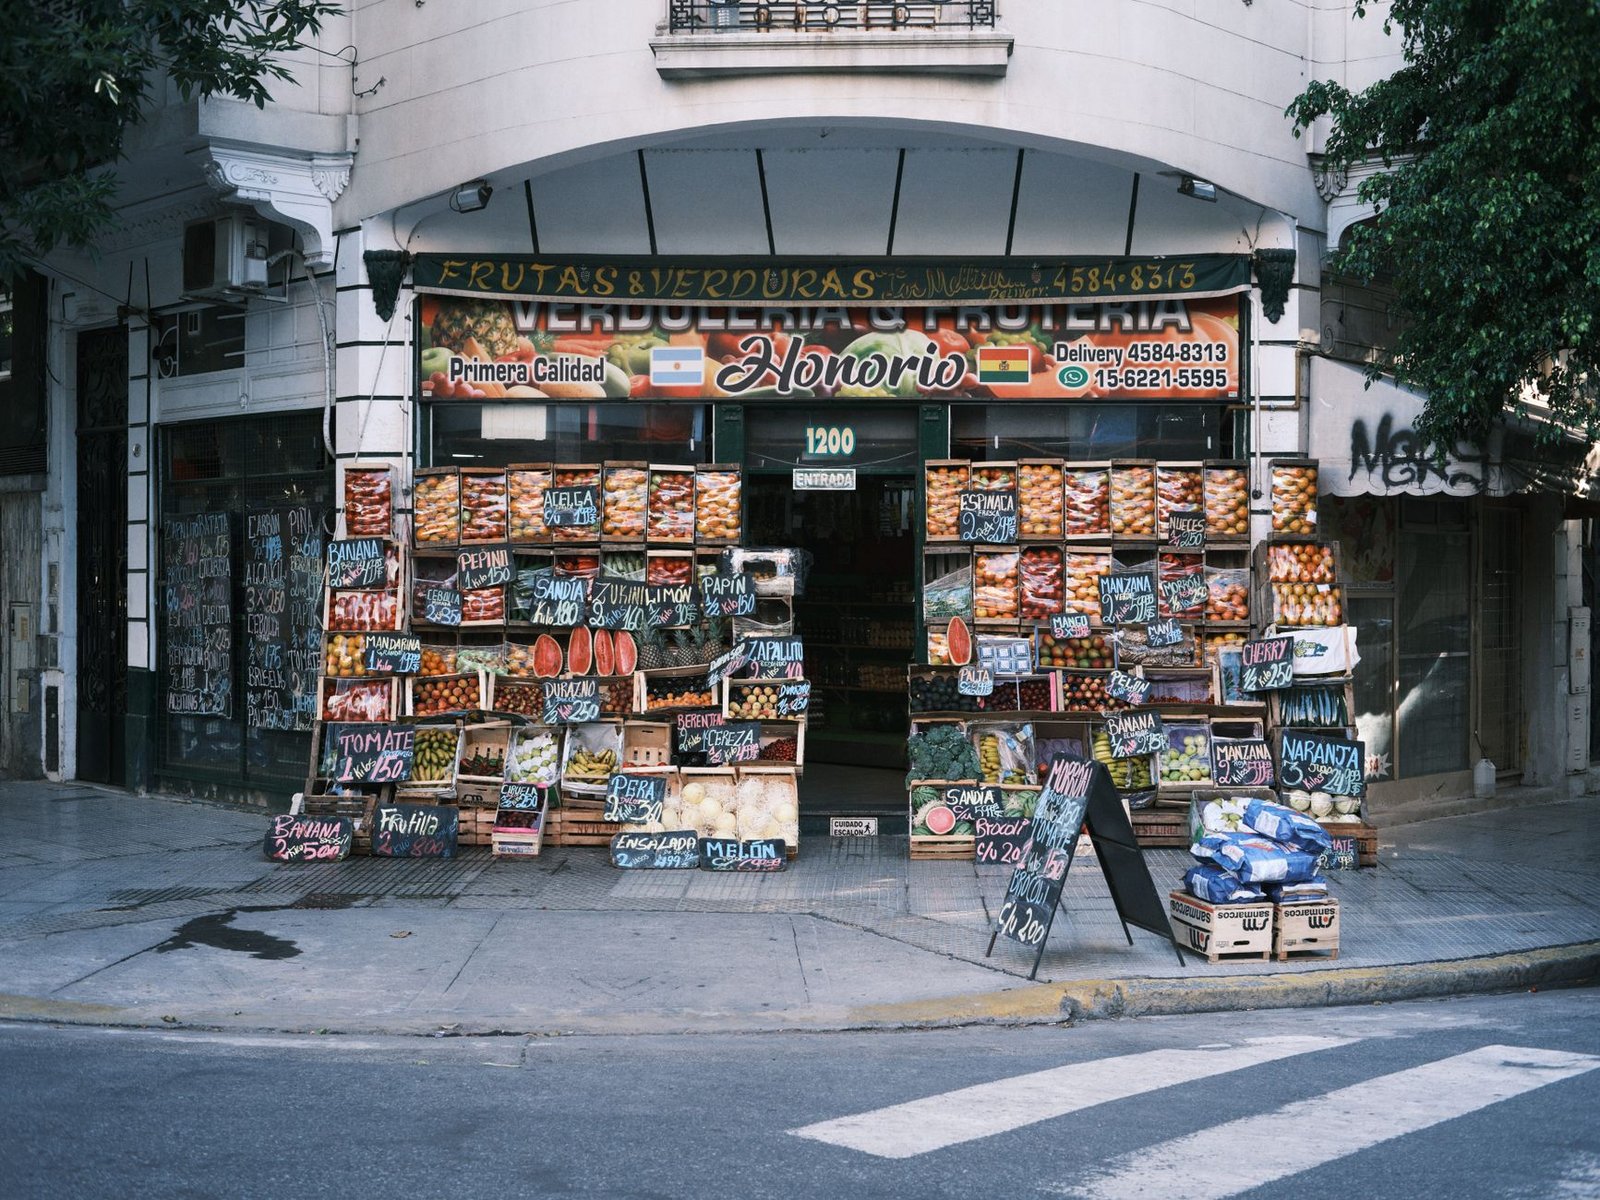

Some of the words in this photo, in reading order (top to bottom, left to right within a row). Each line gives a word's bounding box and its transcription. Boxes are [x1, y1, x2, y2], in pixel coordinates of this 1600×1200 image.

[438, 260, 618, 295] FRUTAS
[627, 271, 645, 295] &
[651, 265, 876, 299] VERDURAS
[716, 335, 966, 392] Honorio
[1056, 343, 1122, 367] Delivery
[1128, 343, 1227, 362] 4584-8313
[449, 357, 528, 382] Primera
[534, 357, 605, 382] Calidad
[1095, 369, 1227, 388] 15-6221-5595
[806, 427, 854, 454] 1200
[795, 472, 853, 487] ENTRADA
[960, 494, 1014, 511] ESPINACA
[288, 507, 314, 536] PIÑA
[1169, 517, 1205, 532] NUECES
[303, 530, 320, 556] 600
[328, 540, 379, 564] BANANA
[487, 567, 510, 587] 150
[702, 574, 745, 595] PAPÍN
[1100, 576, 1151, 594] MANZANA
[1163, 574, 1201, 597] MORRÓN
[247, 587, 255, 612] 3
[267, 589, 285, 613] 250
[534, 577, 584, 602] SANDÍA
[645, 585, 692, 605] LIMÓN
[554, 600, 578, 626] 180
[737, 593, 755, 614] 150
[1101, 594, 1115, 623] 2
[589, 602, 605, 626] 2
[623, 604, 645, 630] 160
[1053, 615, 1088, 628] MANGO
[215, 627, 231, 650] 225
[366, 635, 421, 651] MANDARINA
[367, 650, 377, 671] 1
[1243, 639, 1287, 667] CHERRY
[959, 668, 990, 683] PALTA
[1111, 670, 1150, 693] PELÓN
[1243, 667, 1257, 690] 1/2
[1266, 662, 1293, 687] 250
[545, 681, 596, 698] DURAZNO
[568, 700, 599, 722] 250
[1108, 713, 1155, 736] BANANA
[340, 730, 414, 756] TOMATE
[708, 730, 754, 746] CEREZA
[1217, 743, 1271, 761] MANZANA
[1282, 736, 1358, 770] NARANJA
[337, 757, 354, 781] 1
[370, 754, 403, 782] 150
[1218, 760, 1231, 784] 2
[1282, 760, 1303, 785] 3
[611, 775, 655, 800] PERA
[947, 786, 994, 805] SANDÍA
[516, 795, 538, 808] 250
[604, 795, 619, 822] 2
[272, 815, 341, 839] BANANA
[273, 838, 289, 859] 2
[303, 842, 341, 859] 500
[379, 831, 393, 855] 2
[410, 836, 444, 856] 800
[616, 835, 696, 850] ENSALADA
[706, 841, 775, 858] MELÓN
[617, 853, 633, 867] 2
[1218, 910, 1270, 918] sanmarcos
[1284, 909, 1335, 917] sanmarcos
[1018, 906, 1045, 944] 200
